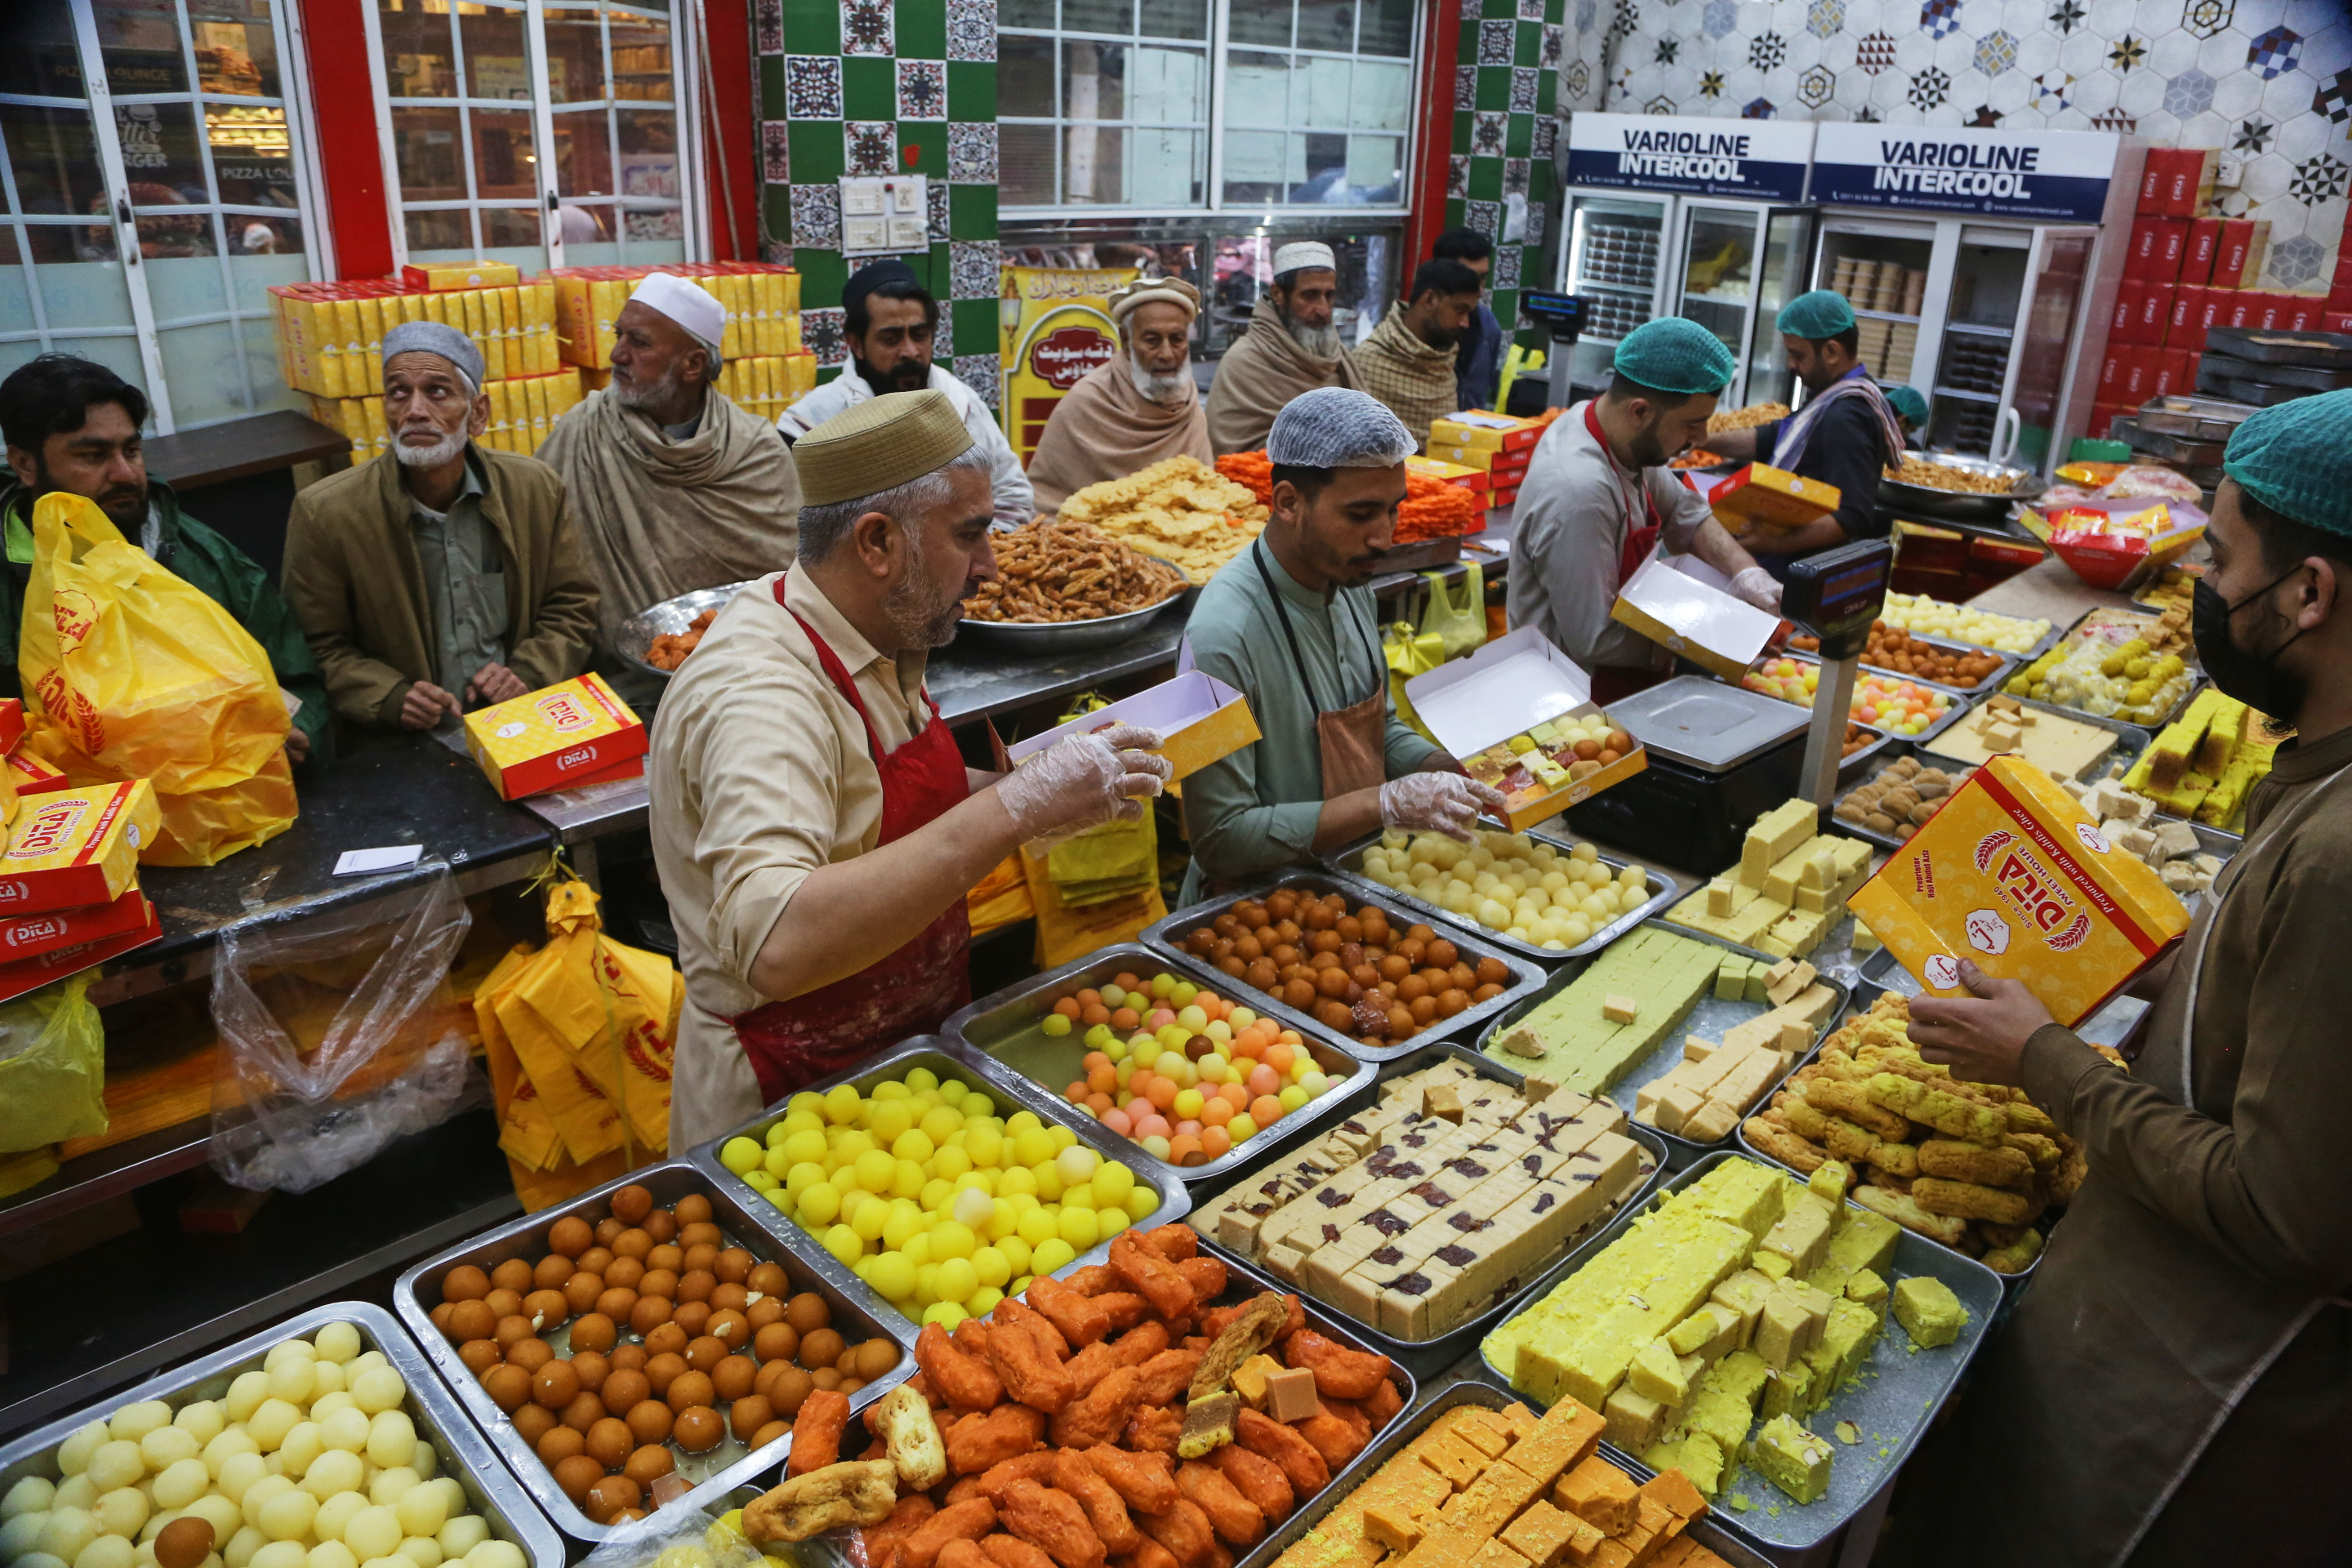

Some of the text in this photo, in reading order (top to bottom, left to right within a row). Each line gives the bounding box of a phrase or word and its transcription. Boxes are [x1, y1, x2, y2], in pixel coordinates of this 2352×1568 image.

[1624, 129, 1750, 158] VARIOLINE
[1882, 140, 2040, 172] VARIOLINE
[221, 167, 263, 180] PIZZA
[1618, 153, 1746, 183] INTERCOOL
[1873, 167, 2032, 199] INTERCOOL
[85, 830, 105, 849] Prepared
[98, 820, 109, 831] with
[1913, 857, 1924, 893] Proprietor
[1925, 864, 1934, 884] Abdul
[2013, 808, 2115, 914] Prepared with Kahlis Ghee
[2018, 846, 2074, 906] SWEET HOUSE
[1927, 884, 1936, 898] Haji
[1993, 886, 2033, 930] Since: 1940
